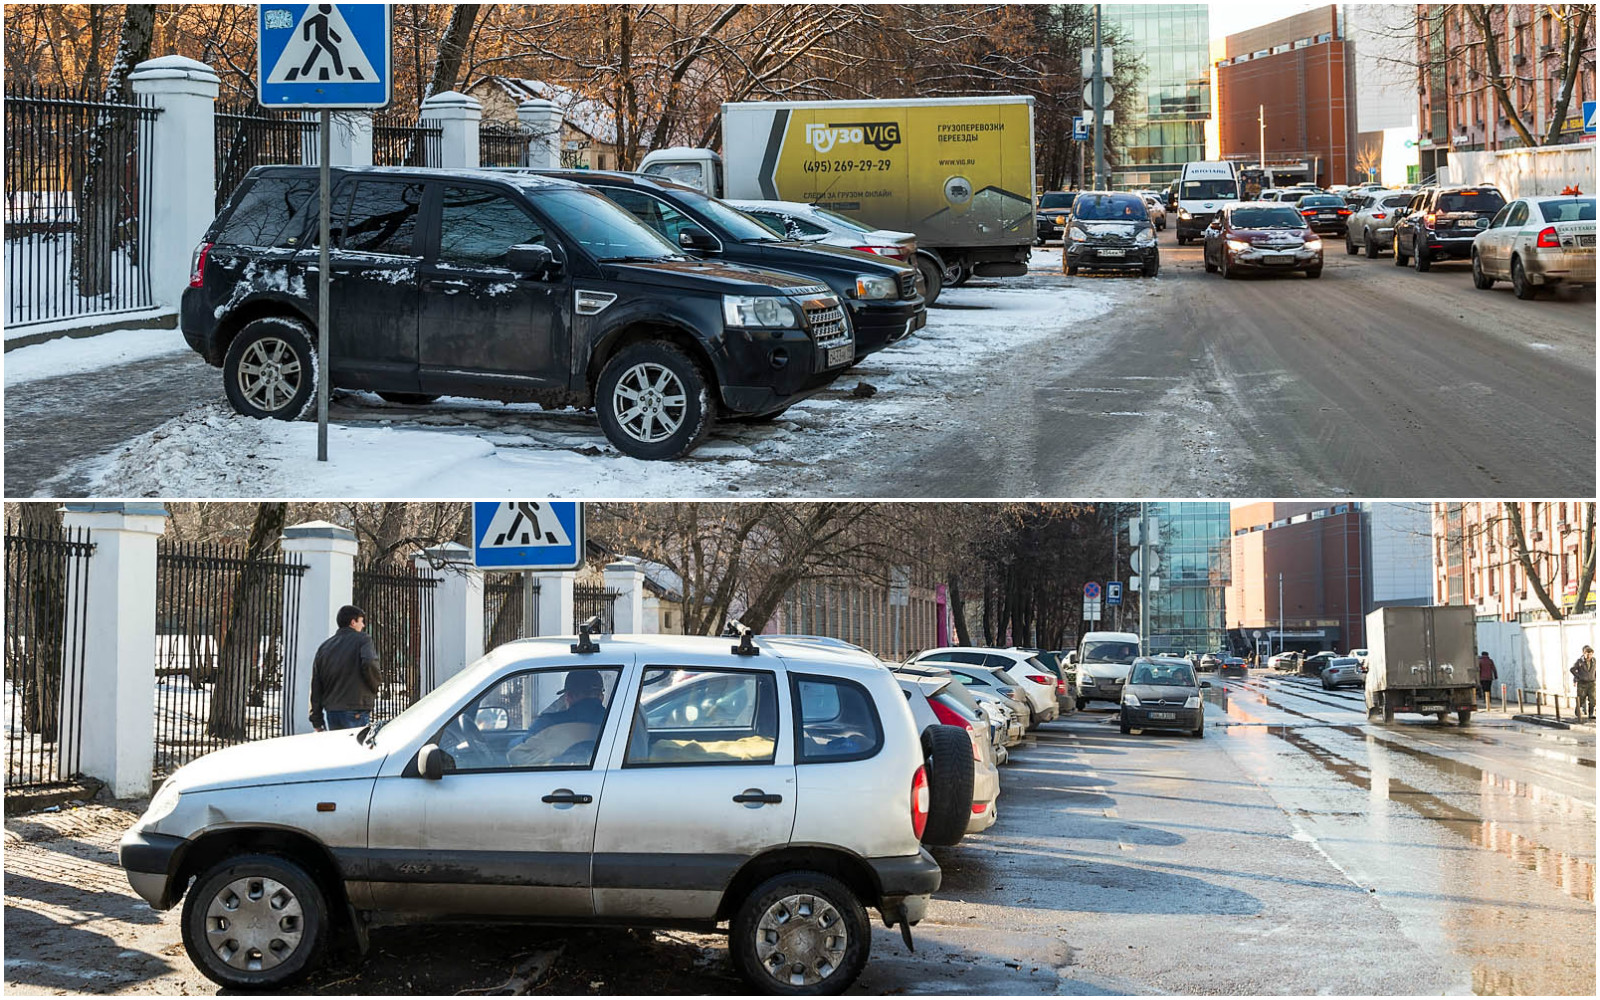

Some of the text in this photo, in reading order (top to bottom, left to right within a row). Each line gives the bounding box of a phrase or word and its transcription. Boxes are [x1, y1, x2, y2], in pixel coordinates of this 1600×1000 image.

[937, 123, 1005, 133] ГРУЗОПЕРЕВОЗКИ
[937, 134, 979, 143] ПЕРЕЕЗДЫ
[803, 159, 891, 173] (495) 269-29-29
[827, 191, 837, 199] ЗА
[838, 190, 864, 199] ГРУЗОМ
[864, 190, 892, 198] ОНЛАЙН
